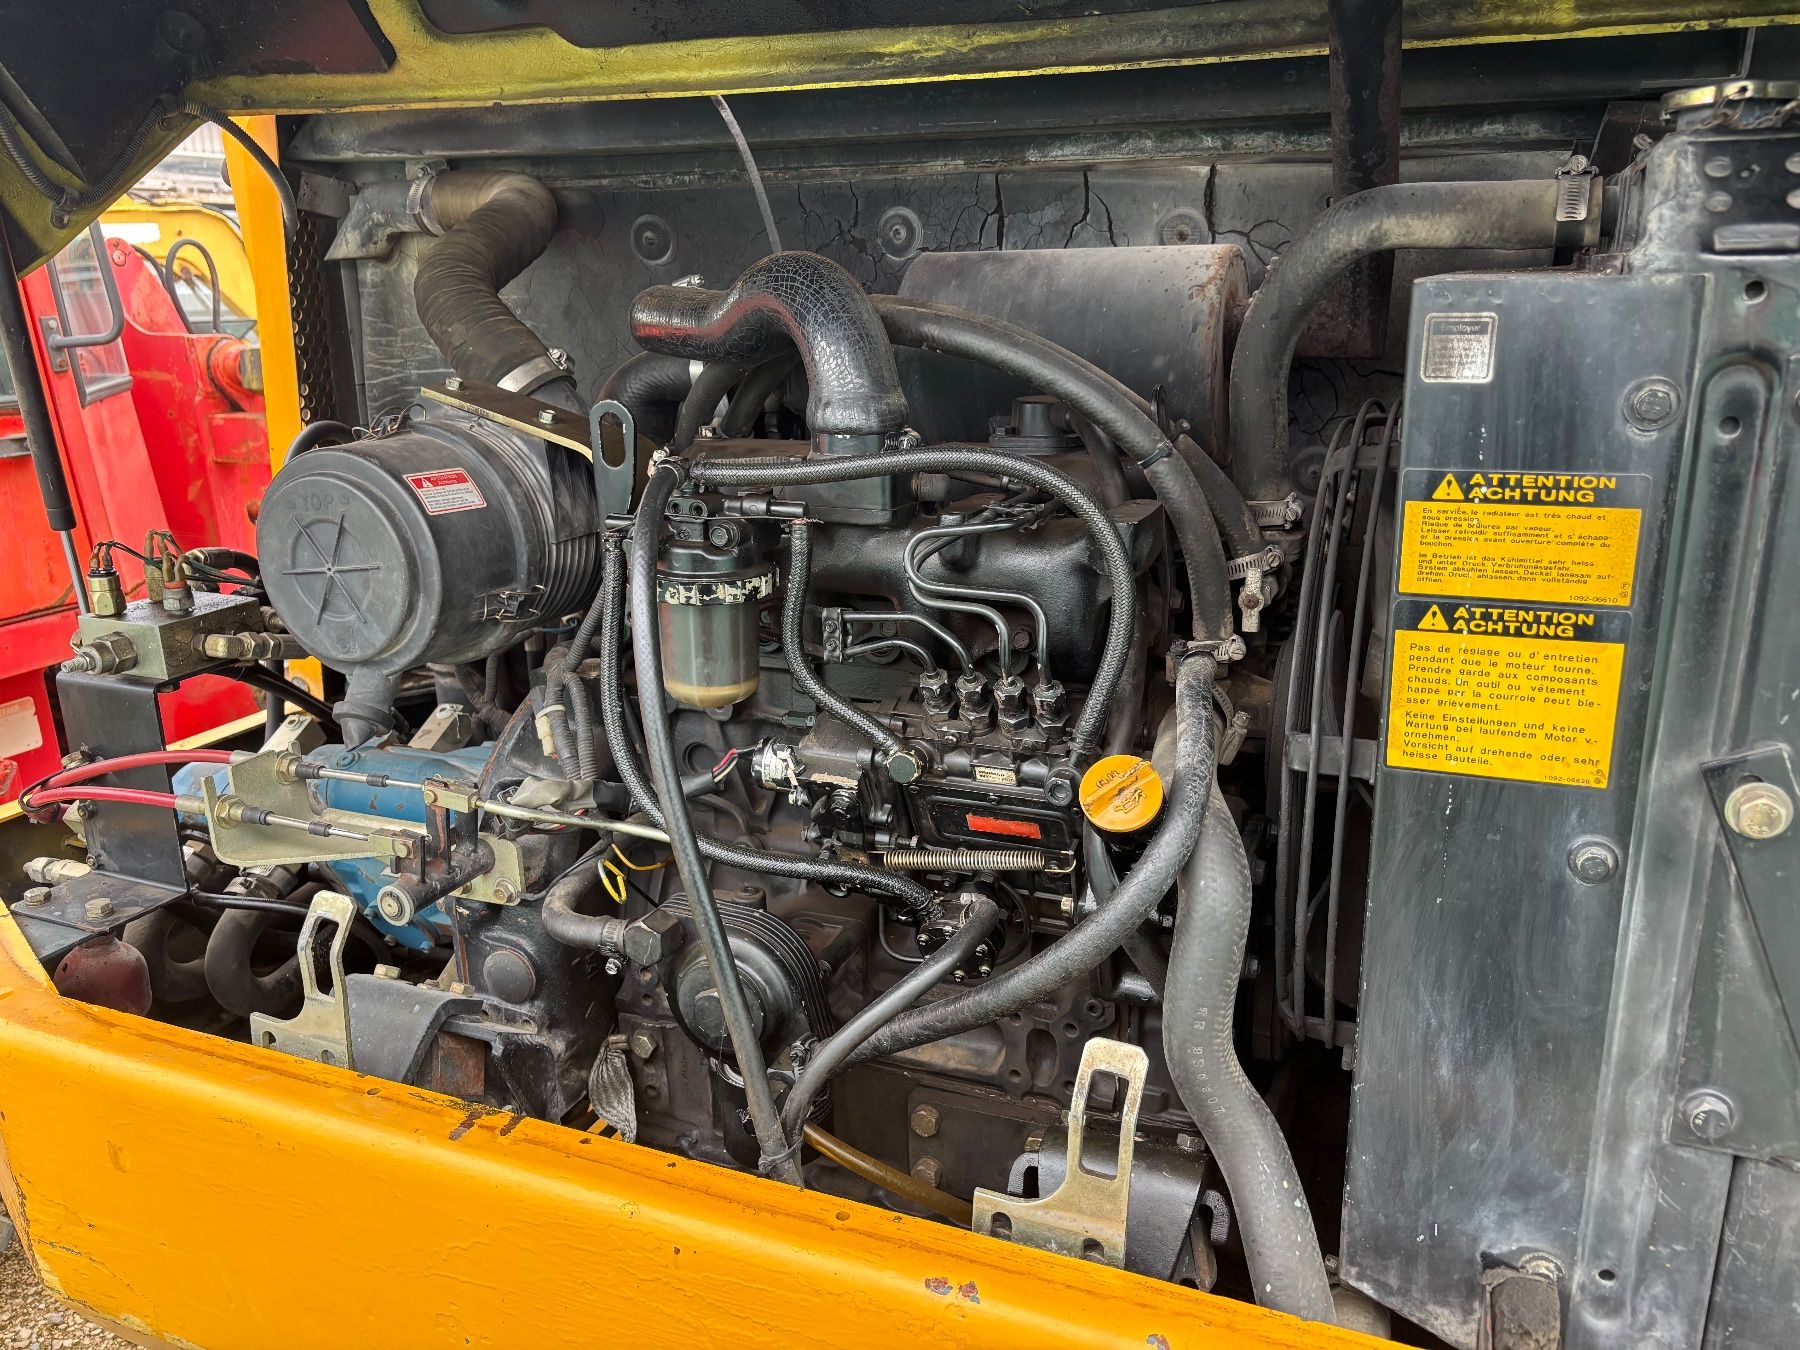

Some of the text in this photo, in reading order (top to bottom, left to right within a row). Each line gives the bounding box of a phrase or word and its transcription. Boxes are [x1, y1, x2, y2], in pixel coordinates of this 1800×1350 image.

[1469, 473, 1617, 489] ATTENTION
[1468, 487, 1595, 503] ACHTUNG
[1422, 520, 1449, 528] Risque
[1493, 531, 1549, 539] suffisamment
[1454, 606, 1595, 626] ATTENTION
[1452, 619, 1574, 638] ACHTUNG
[1410, 642, 1431, 652] Pas
[1438, 645, 1451, 653] de
[1543, 654, 1598, 664] entretien
[1409, 654, 1595, 675] pendant que le moteur tourne.
[1408, 664, 1452, 675] Prendre
[1459, 668, 1491, 677] garde
[1526, 674, 1598, 686] composants
[1408, 675, 1451, 685] chauds.
[1455, 678, 1469, 686] Un
[1476, 681, 1500, 689] outil
[1531, 684, 1586, 696] vêtement
[1447, 689, 1466, 698] par
[1472, 690, 1481, 698] la
[1489, 692, 1536, 703] courroie
[1543, 696, 1570, 705] peut
[1405, 710, 1586, 734] Keine Einstellungen und keine
[1405, 719, 1449, 731] Wartung
[1456, 725, 1473, 733] bei
[1479, 727, 1537, 739] laufendem
[1544, 733, 1577, 743] Motor
[1403, 731, 1459, 742] ornehmen.
[1402, 750, 1492, 766] heisse Bauteile.
[1403, 739, 1600, 766] Vorsicht auf drehende oder sehr
